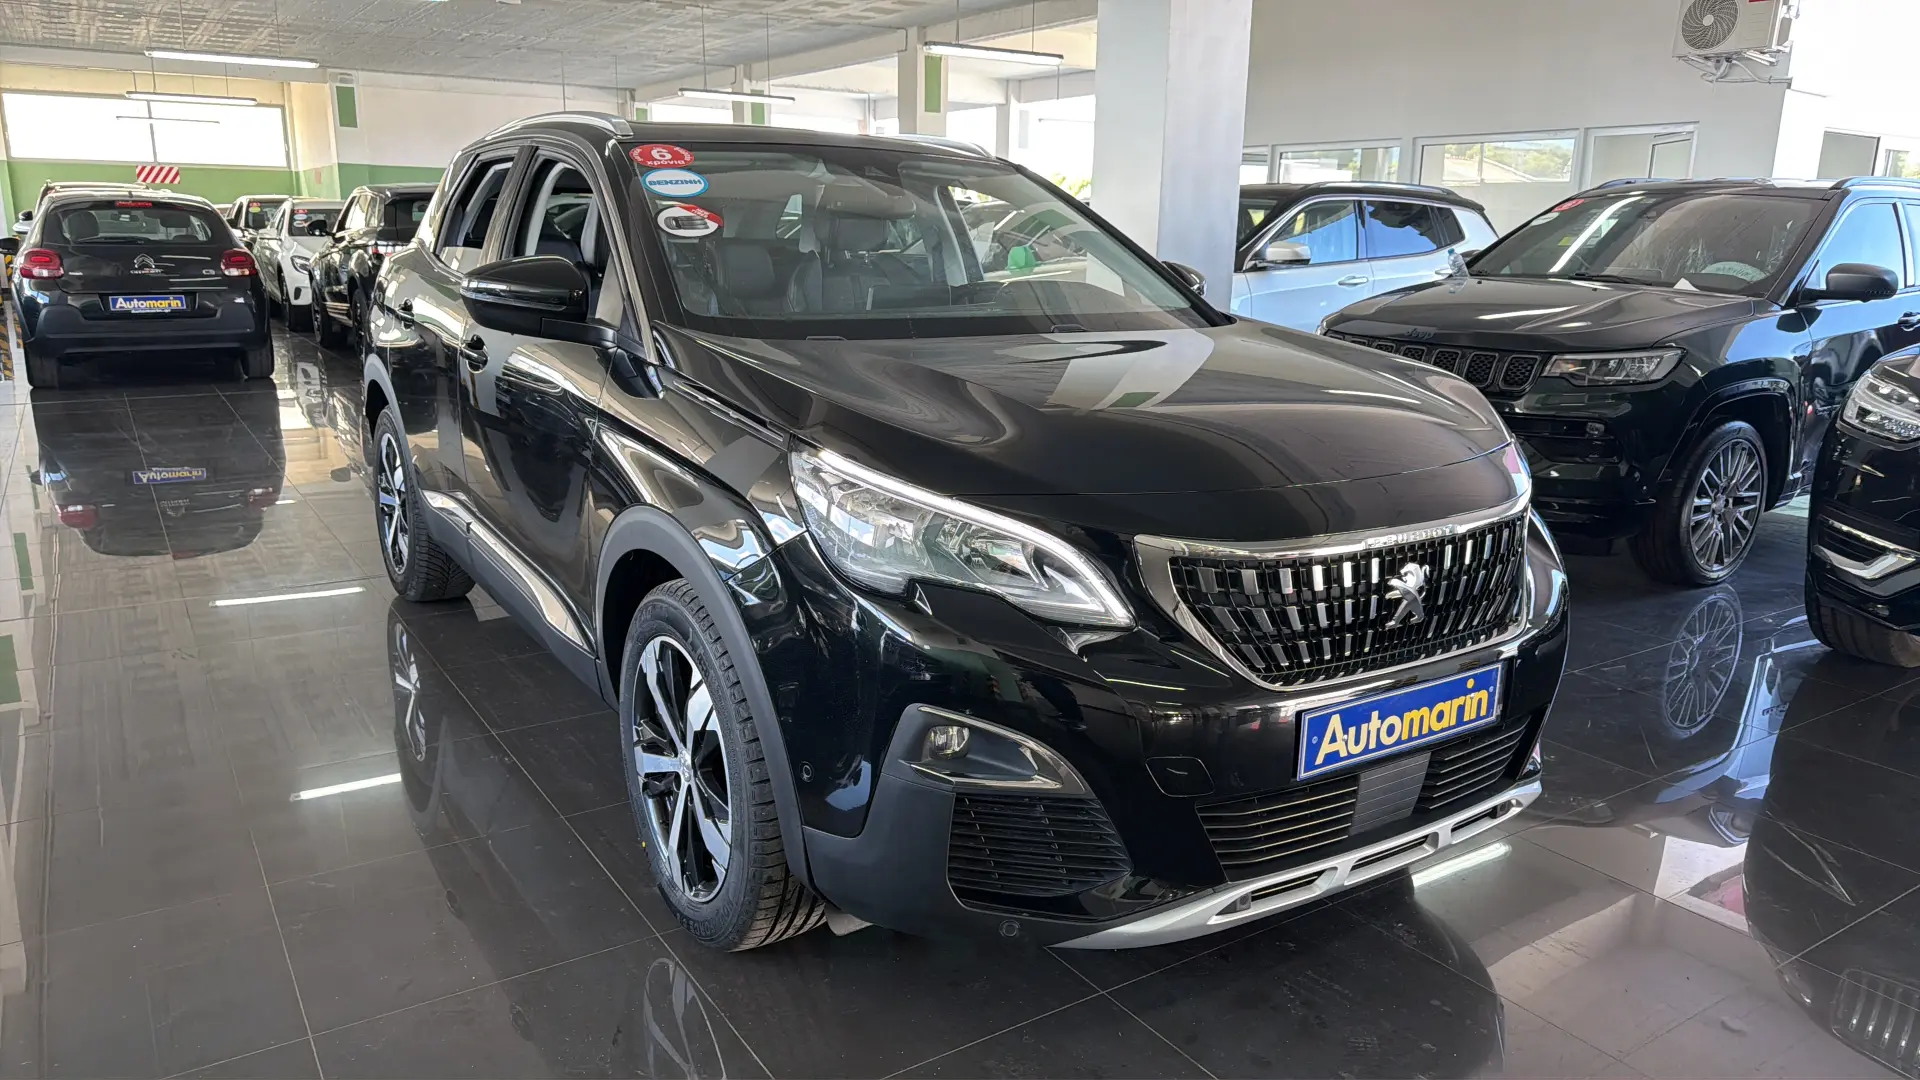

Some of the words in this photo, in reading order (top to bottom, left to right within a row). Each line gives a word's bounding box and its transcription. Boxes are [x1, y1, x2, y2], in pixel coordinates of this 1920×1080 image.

[651, 149, 672, 160] 6
[115, 297, 182, 309] Automarin
[1405, 328, 1435, 340] Jeep
[1314, 678, 1489, 766] Automarin
